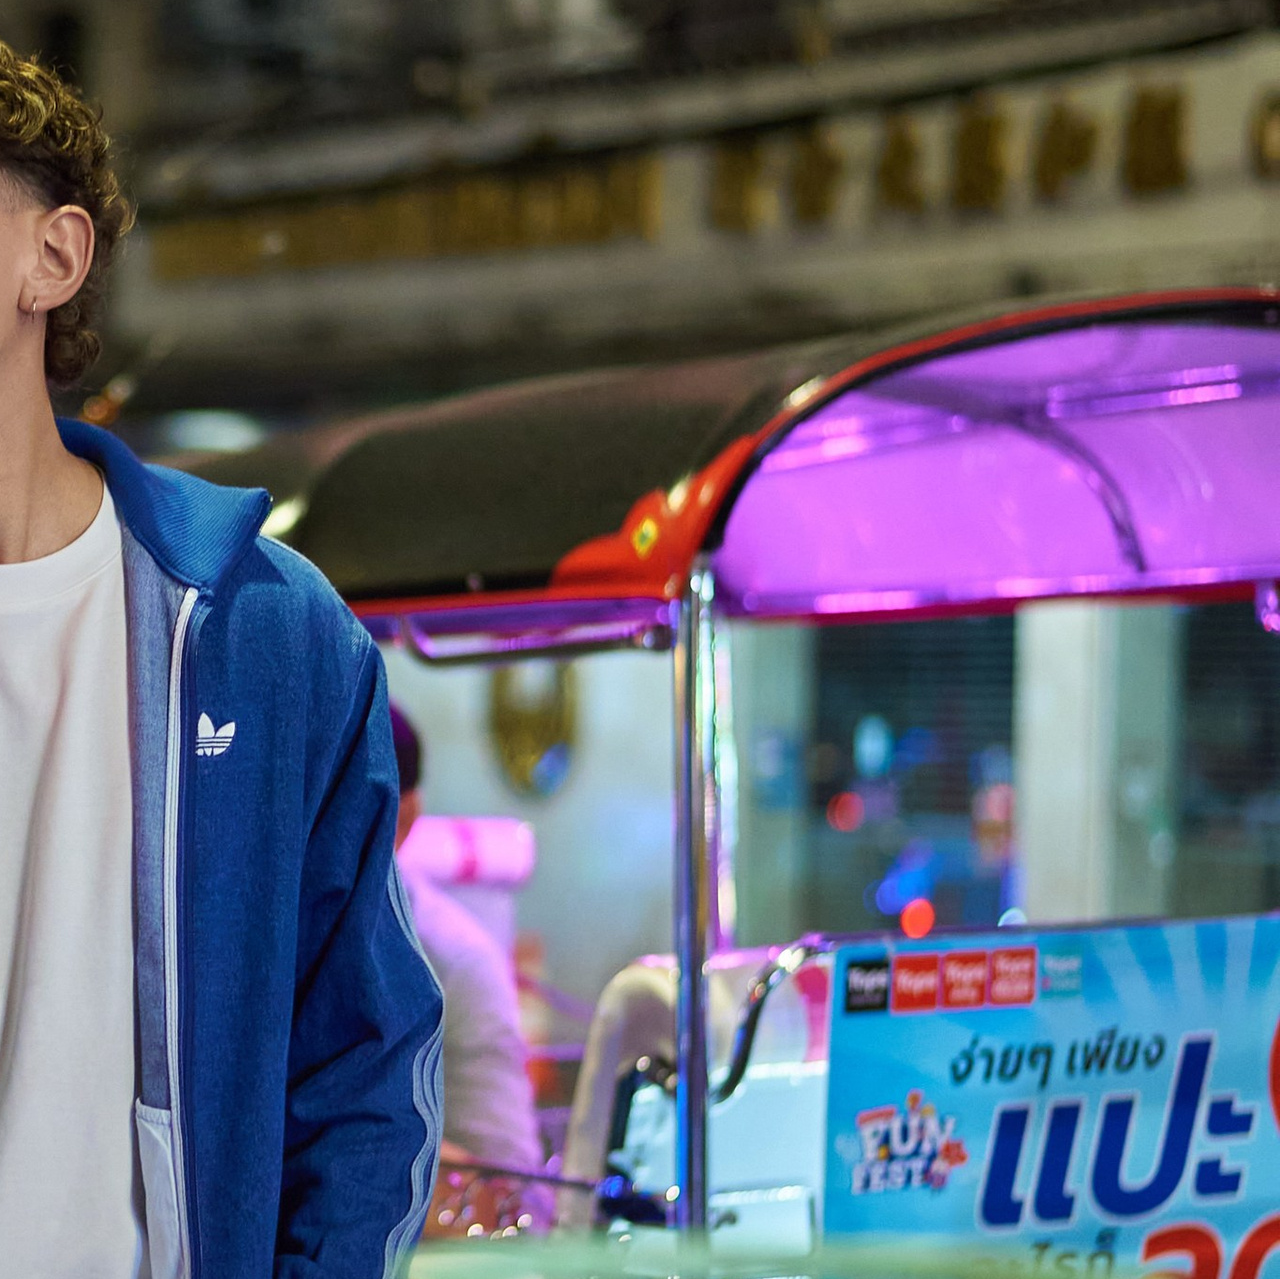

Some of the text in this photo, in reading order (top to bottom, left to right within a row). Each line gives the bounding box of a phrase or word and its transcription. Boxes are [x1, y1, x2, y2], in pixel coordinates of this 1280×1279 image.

[950, 1033, 1055, 1093] ง่ายๆ
[858, 1107, 957, 1163] FUN
[979, 1036, 1256, 1229] แปะ
